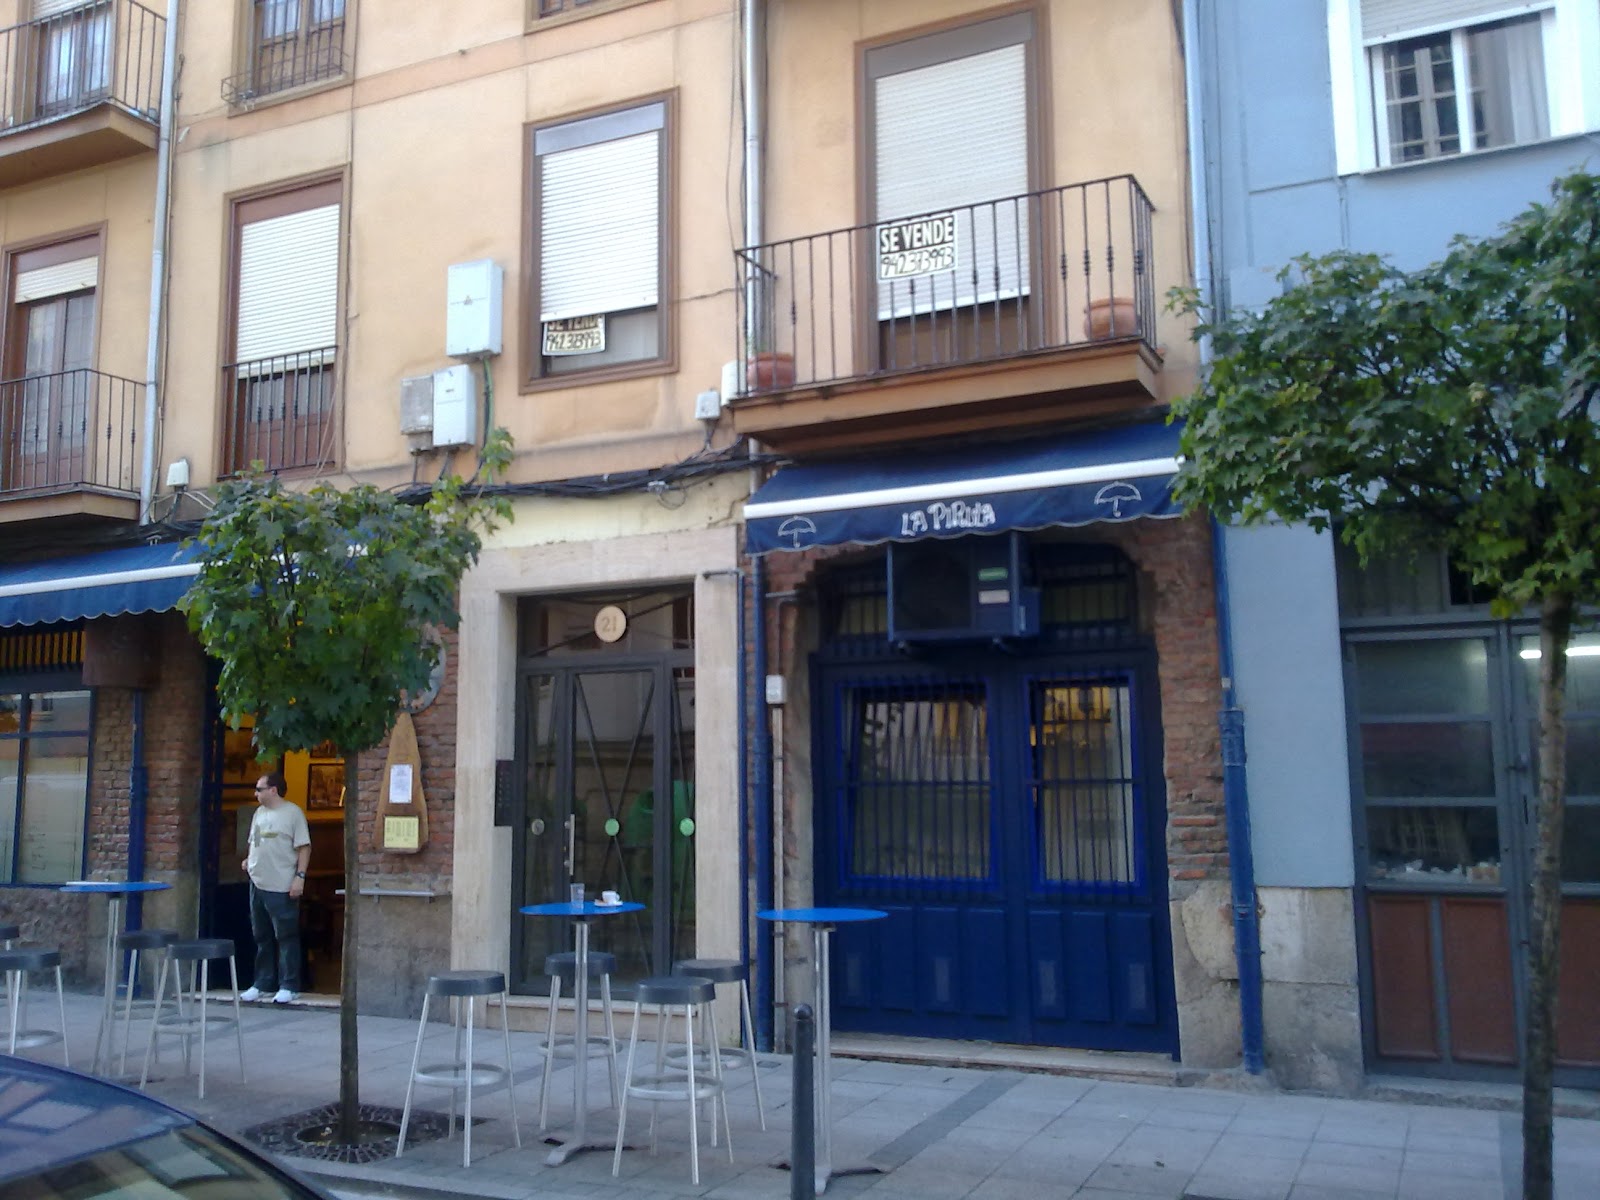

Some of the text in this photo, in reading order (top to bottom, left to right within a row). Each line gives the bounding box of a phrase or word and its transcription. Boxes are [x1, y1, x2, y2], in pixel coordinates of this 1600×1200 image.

[881, 217, 954, 253] SE VENDE
[901, 510, 928, 536] LA
[602, 616, 617, 633] 21
